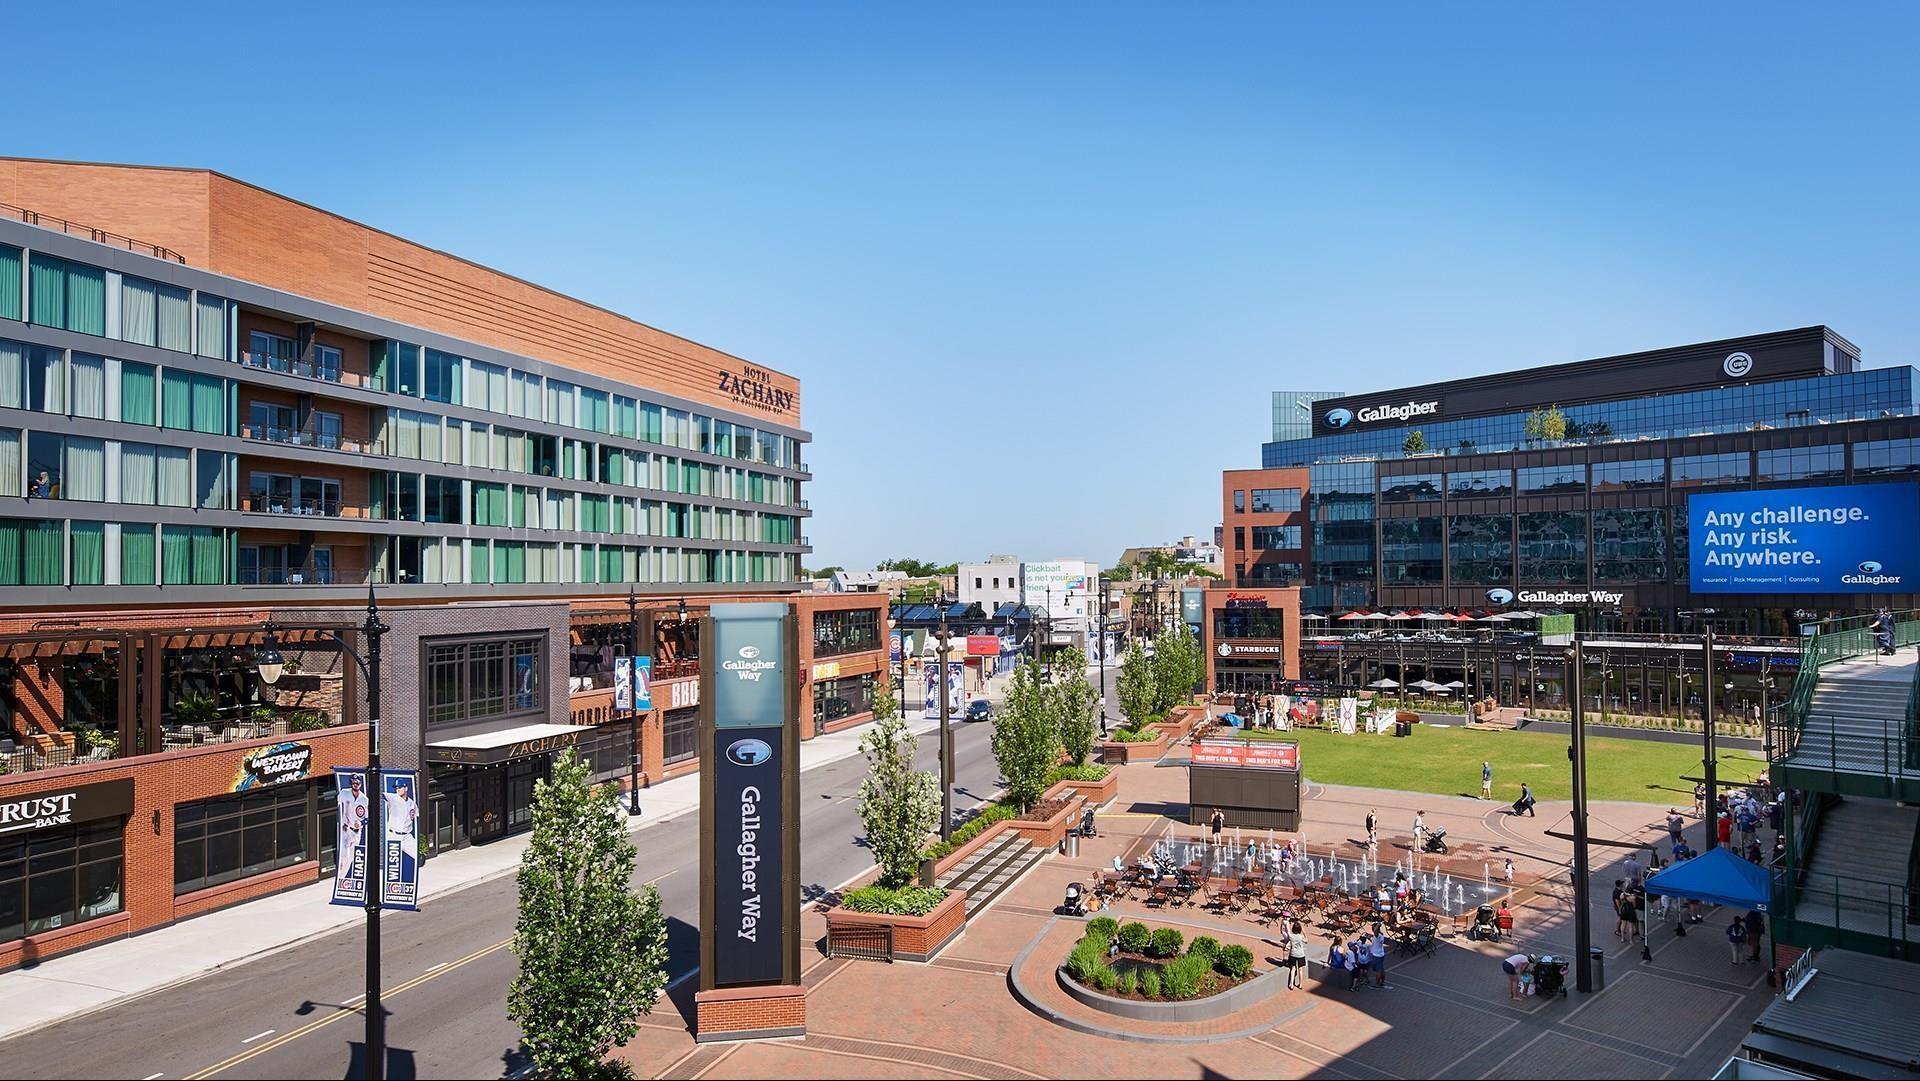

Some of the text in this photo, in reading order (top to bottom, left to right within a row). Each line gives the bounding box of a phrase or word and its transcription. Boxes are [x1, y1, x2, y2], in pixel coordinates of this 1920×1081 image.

[744, 366, 771, 384] HOTEL
[719, 371, 793, 409] ZACHARY
[1357, 401, 1438, 422] Gallagher
[1704, 506, 1869, 528] Any challenge.
[1704, 528, 1798, 548] Any risk.
[1705, 549, 1821, 568] Anywhere.
[1025, 565, 1061, 573] Clickbait
[1026, 574, 1032, 582] is
[1788, 576, 1820, 584] Consulting
[1841, 574, 1901, 585] Gallagher
[1518, 591, 1623, 604] Gallagher Way
[722, 661, 776, 671] Gallagher
[738, 671, 761, 681] Way
[509, 732, 579, 757] ZACHARY
[263, 759, 304, 775] BAKERY
[0, 793, 76, 823] RUST
[35, 814, 71, 828] BANK
[354, 849, 364, 878] HAPP
[388, 842, 400, 881] WILSON
[737, 786, 761, 942] Gallagher Way
[357, 881, 362, 889] 8
[405, 885, 413, 894] 37
